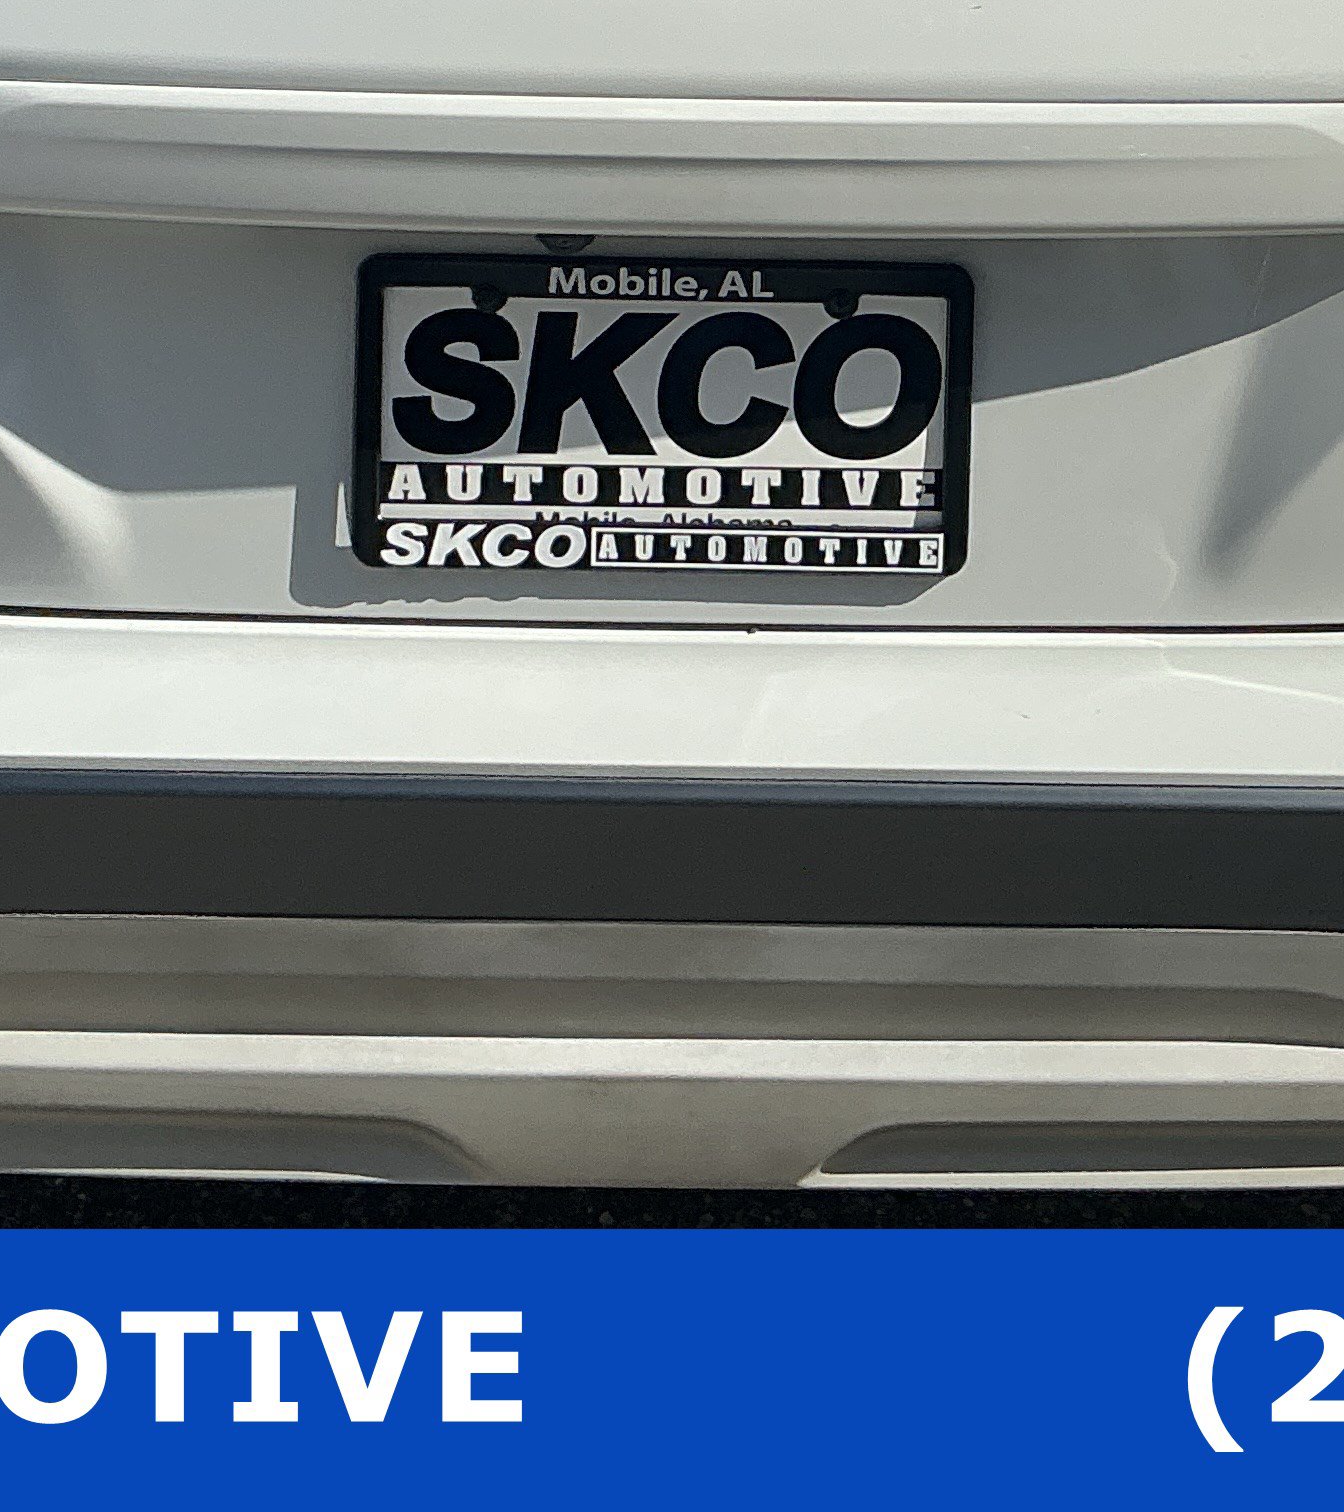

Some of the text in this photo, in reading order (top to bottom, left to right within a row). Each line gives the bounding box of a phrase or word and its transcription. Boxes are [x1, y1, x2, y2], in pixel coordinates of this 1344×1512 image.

[548, 266, 775, 300] Mobile, AL
[391, 307, 944, 461] SKCO
[386, 462, 936, 507] AUTOMOTIVE
[380, 522, 587, 568] SKCO
[598, 532, 938, 567] AUTOMOTIVE
